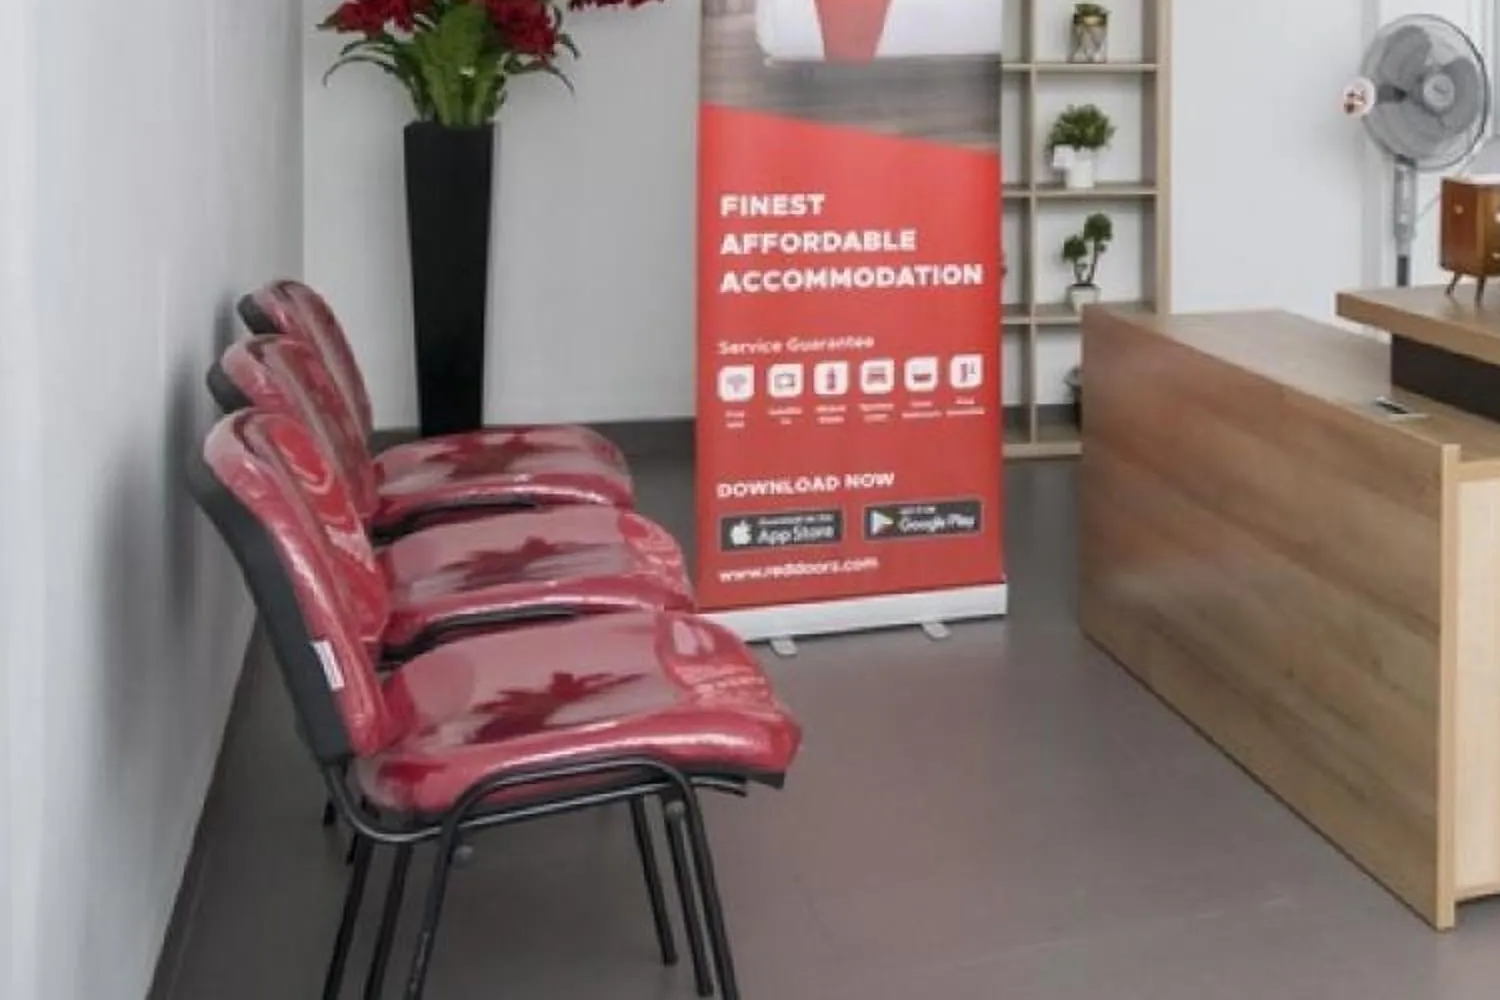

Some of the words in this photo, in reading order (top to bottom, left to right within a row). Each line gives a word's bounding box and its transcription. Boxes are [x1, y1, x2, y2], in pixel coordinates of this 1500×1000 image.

[720, 193, 826, 217] FINEST
[720, 228, 917, 255] AFFORDABLE
[720, 263, 984, 294] ACCOMMODATION
[718, 337, 782, 355] Service
[786, 335, 875, 353] Guarantee
[716, 476, 841, 499] DOWNLOAD
[844, 471, 896, 489] NOW
[756, 527, 792, 546] App
[793, 524, 835, 542] Store
[898, 515, 945, 534] Google
